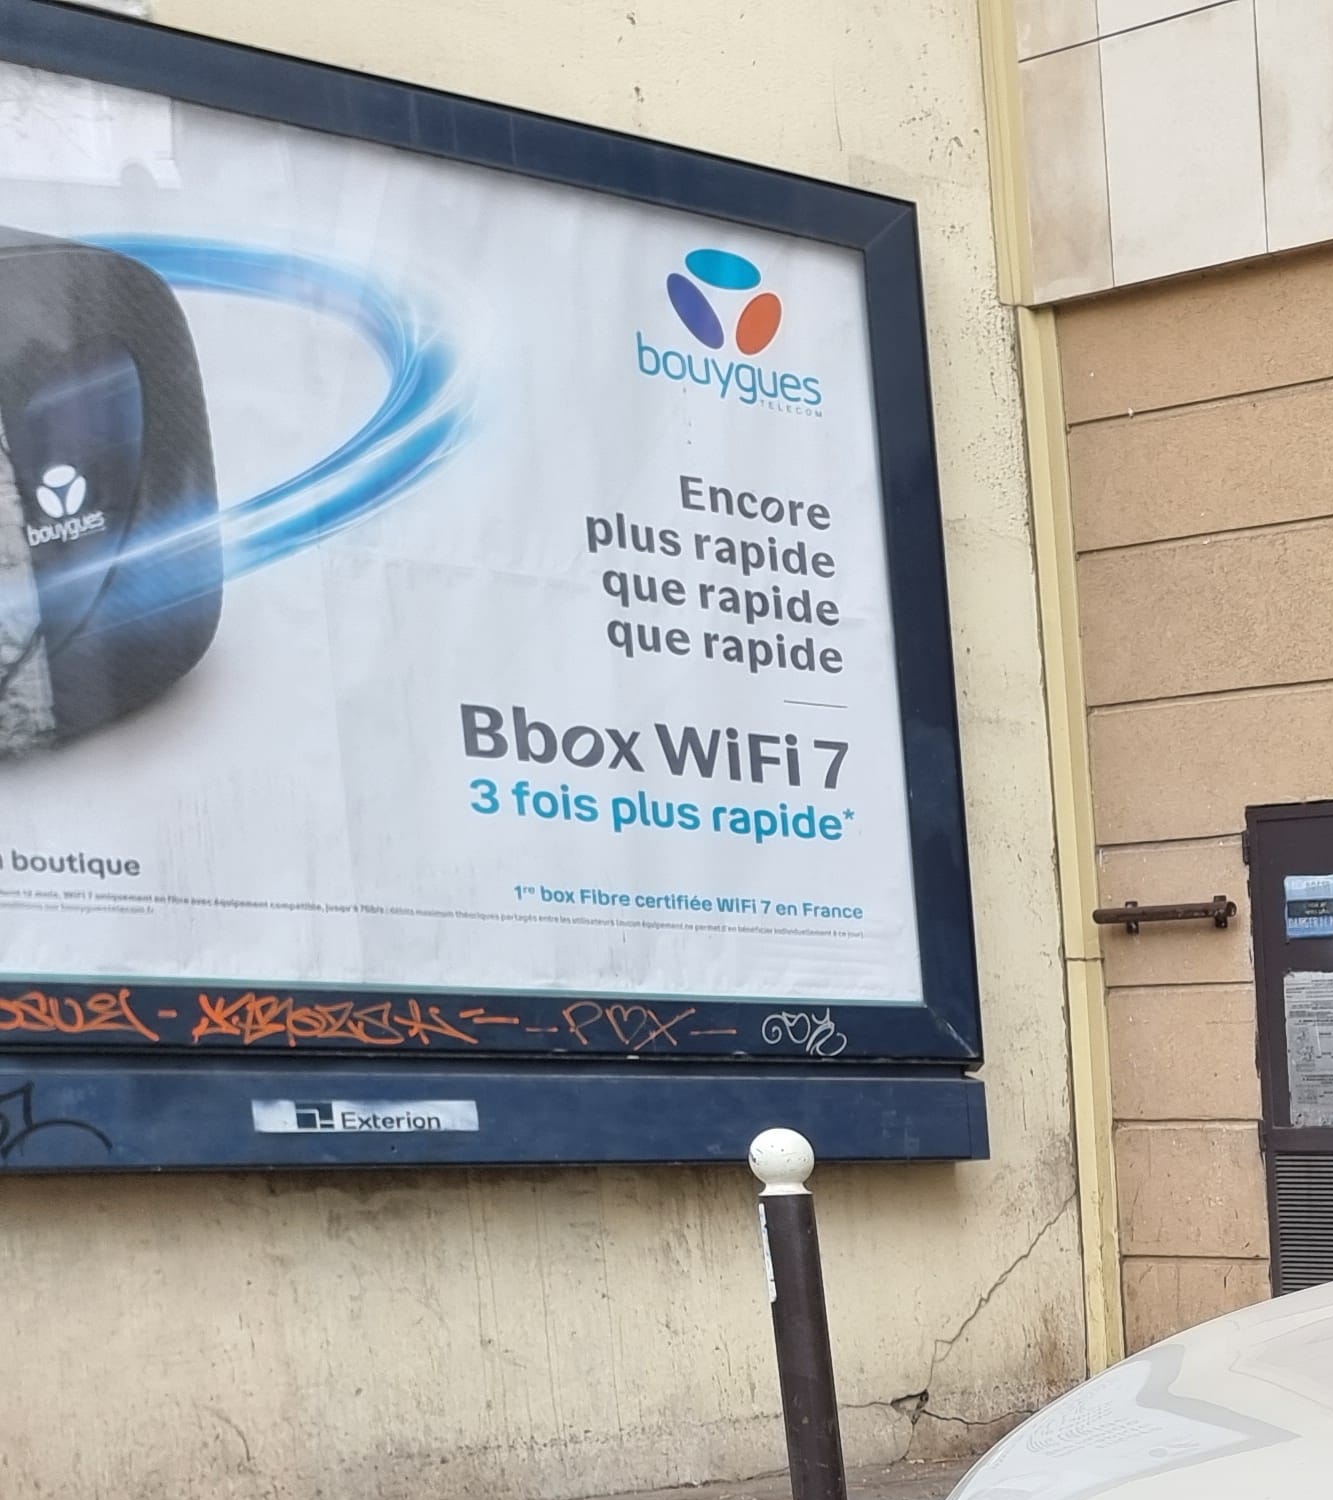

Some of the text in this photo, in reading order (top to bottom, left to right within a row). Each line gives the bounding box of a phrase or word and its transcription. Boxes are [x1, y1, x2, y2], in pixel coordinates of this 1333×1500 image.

[636, 330, 822, 406] bouygues
[27, 511, 105, 547] bouygues
[679, 474, 832, 531] Encore
[586, 512, 836, 579] plus rapide
[602, 569, 840, 627] que rapide
[607, 617, 844, 674] que rapide
[460, 702, 850, 790] Bbox WiFi 7
[469, 778, 500, 815] 3
[511, 779, 599, 822] fois
[612, 790, 701, 833] plus
[11, 849, 141, 880] boutique
[540, 885, 576, 905] box
[580, 887, 631, 908] Fibre
[634, 891, 713, 912] certifiée
[716, 896, 757, 915] WiFi
[760, 899, 772, 915] 7
[775, 902, 799, 917] en
[802, 901, 864, 920] France
[340, 1111, 442, 1132] Exterion
